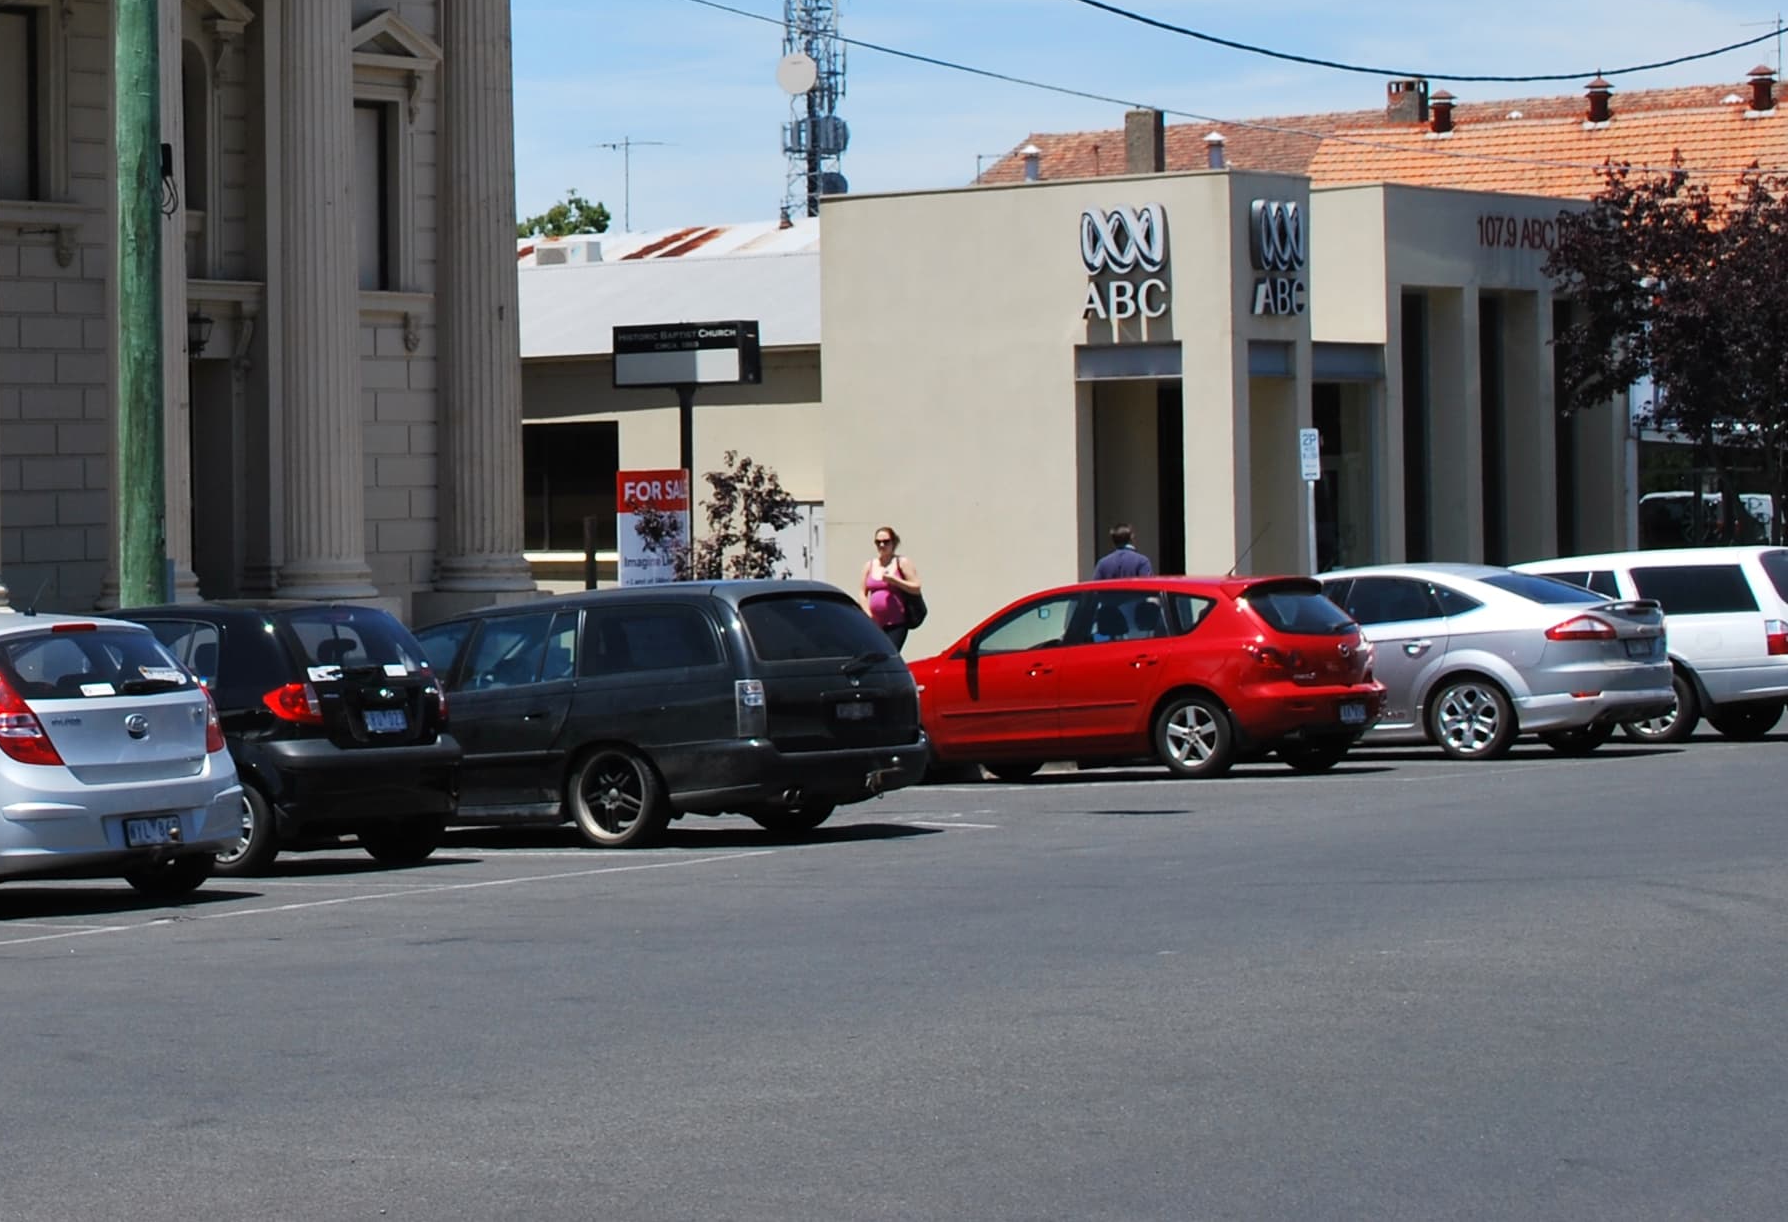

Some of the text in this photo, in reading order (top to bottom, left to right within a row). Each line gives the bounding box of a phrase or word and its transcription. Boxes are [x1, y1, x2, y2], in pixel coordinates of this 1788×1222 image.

[1477, 215, 1516, 248] 107.9
[1521, 218, 1555, 250] ABC
[1082, 278, 1167, 319] ABC
[1253, 278, 1306, 315] ABC
[624, 481, 663, 501] FOR
